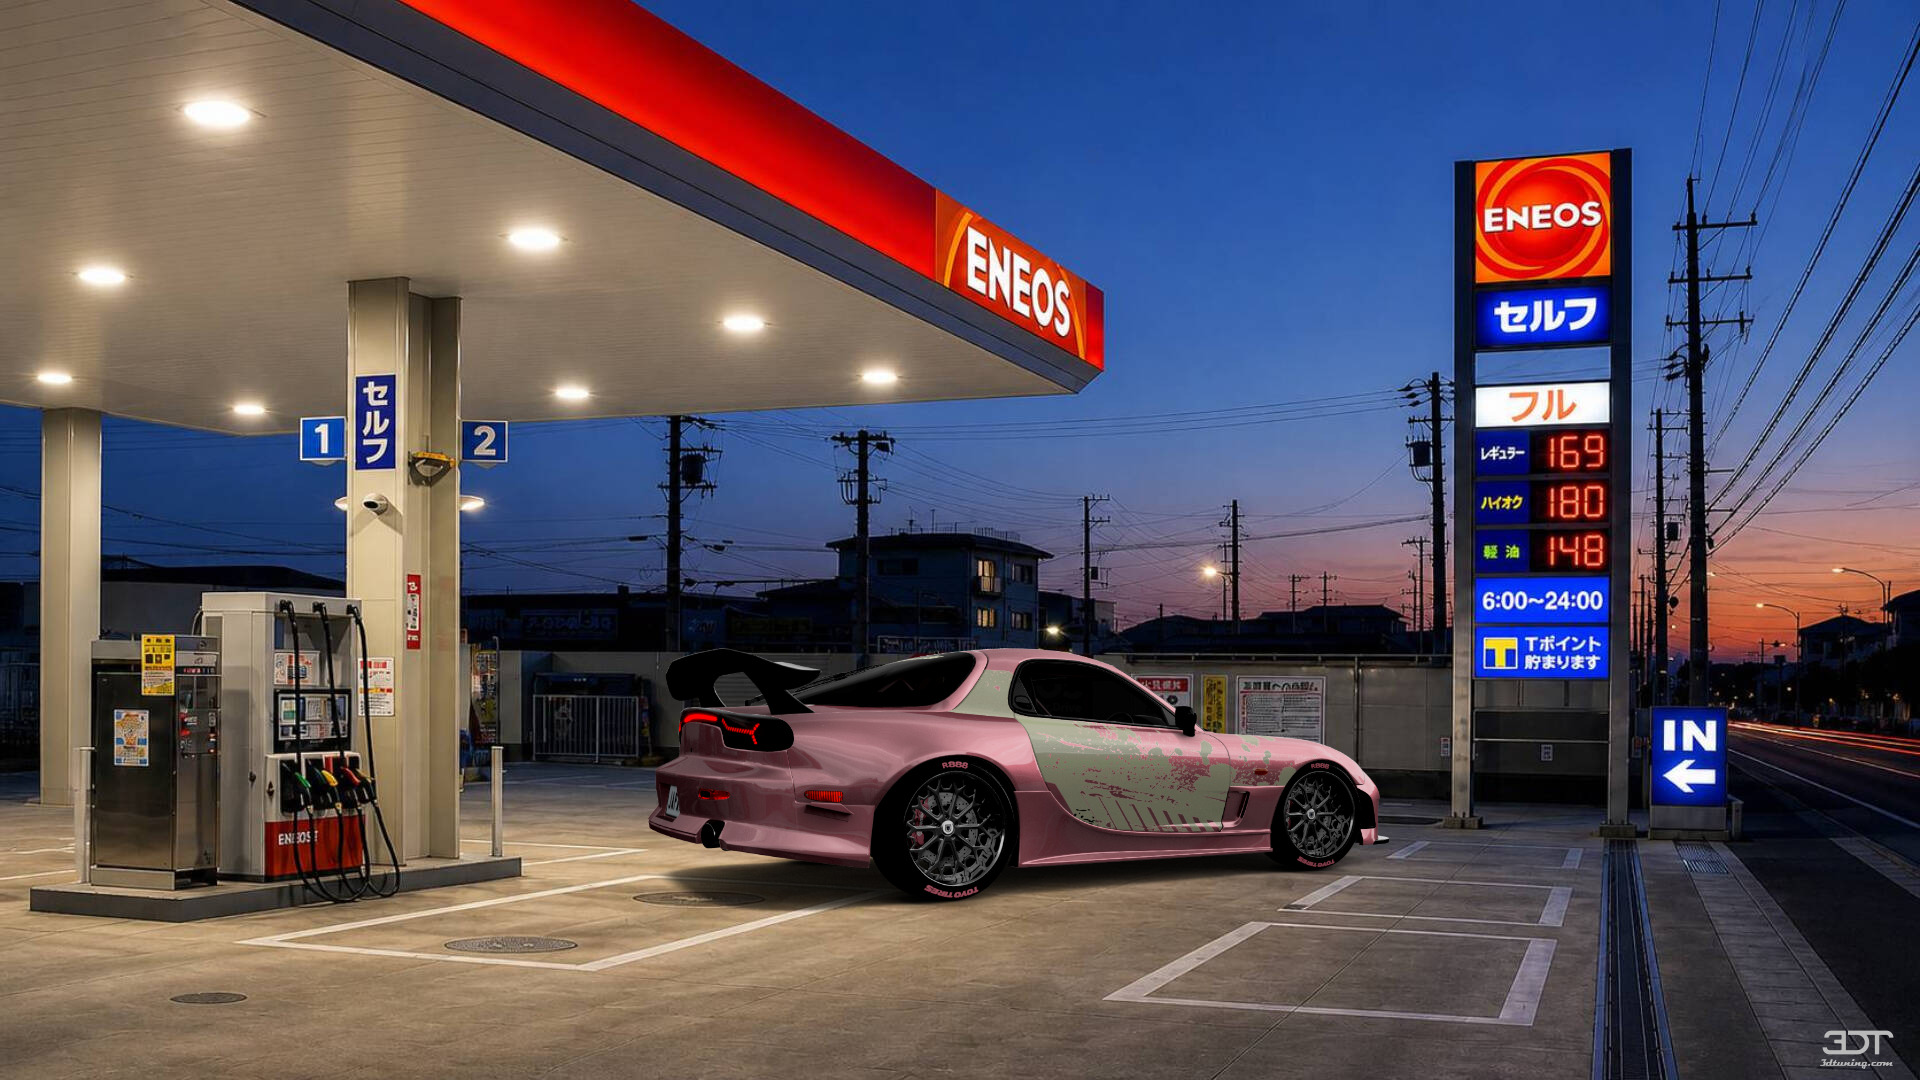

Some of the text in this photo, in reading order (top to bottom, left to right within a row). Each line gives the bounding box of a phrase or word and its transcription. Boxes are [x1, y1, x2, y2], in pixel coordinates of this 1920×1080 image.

[1484, 201, 1602, 232] ENEOS
[967, 225, 1071, 338] ENEOS
[1494, 297, 1597, 333] セルフ
[1508, 388, 1577, 423] フル
[314, 422, 329, 454] 1
[362, 381, 390, 464] セルフ
[473, 425, 497, 456] 2
[1480, 435, 1604, 468] レギュラー 169
[1480, 484, 1604, 518] ハイオク 180
[1549, 534, 1604, 567] 148
[1524, 636, 1602, 653] Tポイント
[1524, 654, 1601, 670] 貯まります
[1663, 719, 1717, 752] IN
[941, 760, 969, 769] R888
[924, 884, 979, 899] TOYO TIRES
